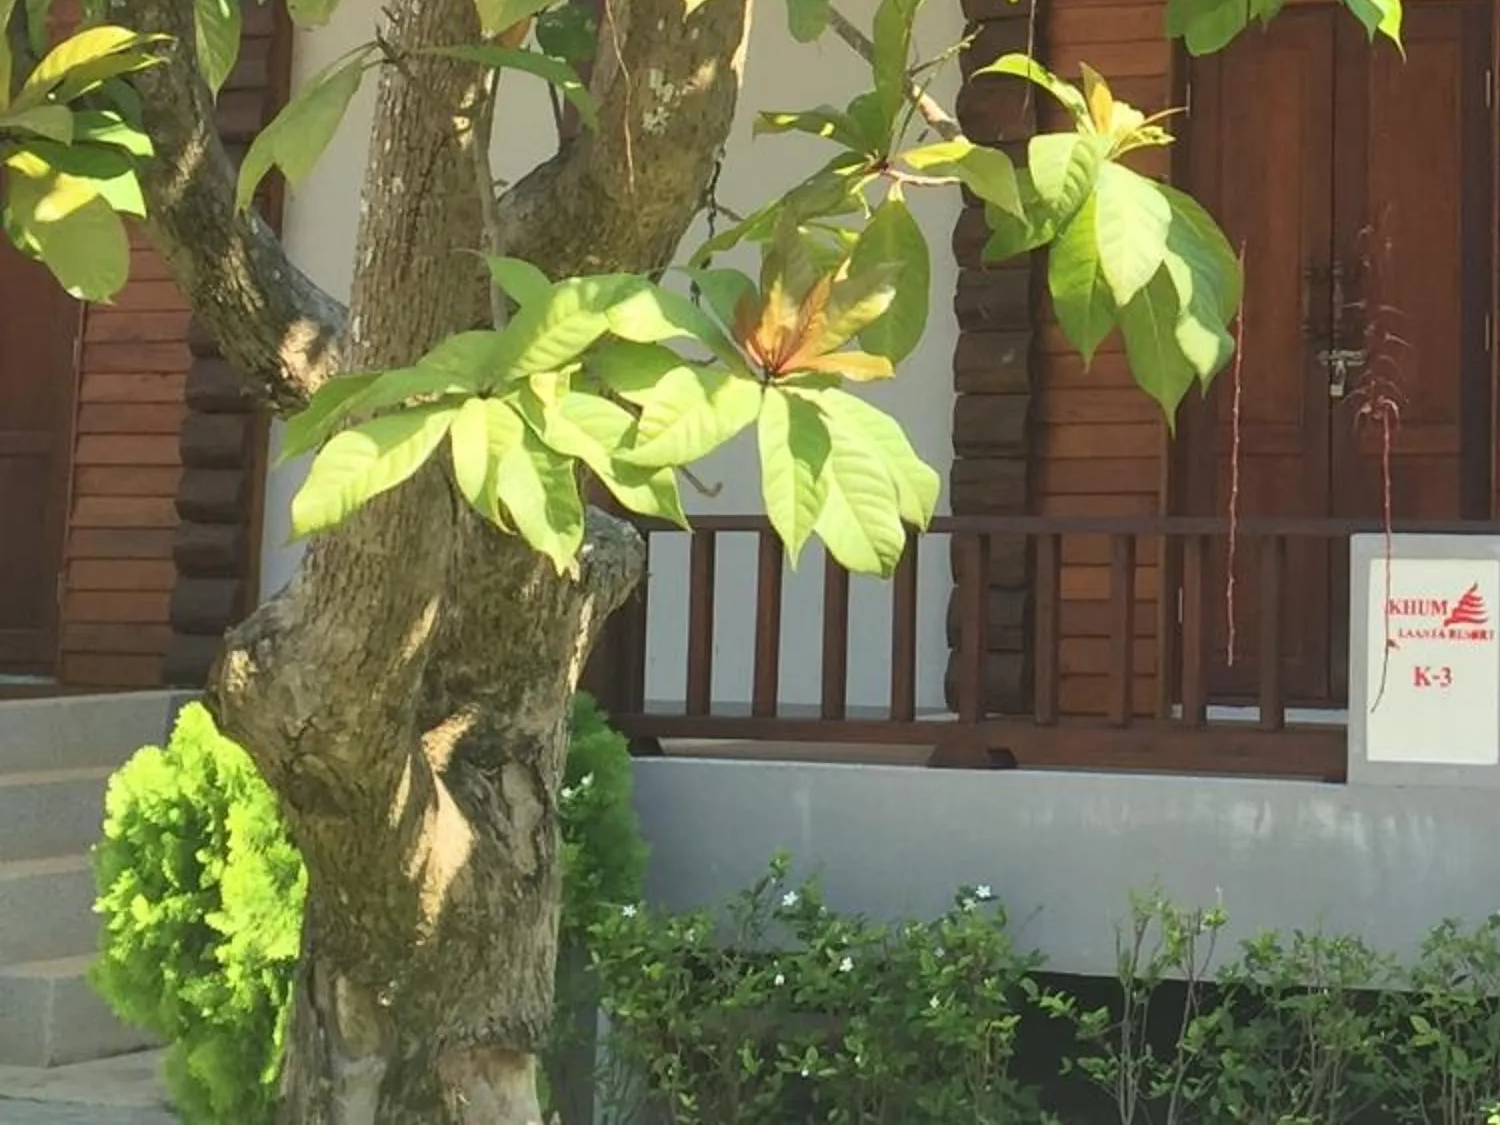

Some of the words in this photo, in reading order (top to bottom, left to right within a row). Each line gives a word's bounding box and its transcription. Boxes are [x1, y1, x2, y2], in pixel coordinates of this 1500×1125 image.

[1387, 598, 1448, 616] KHUM
[1448, 629, 1494, 641] RESORT
[1413, 666, 1453, 687] K-3
